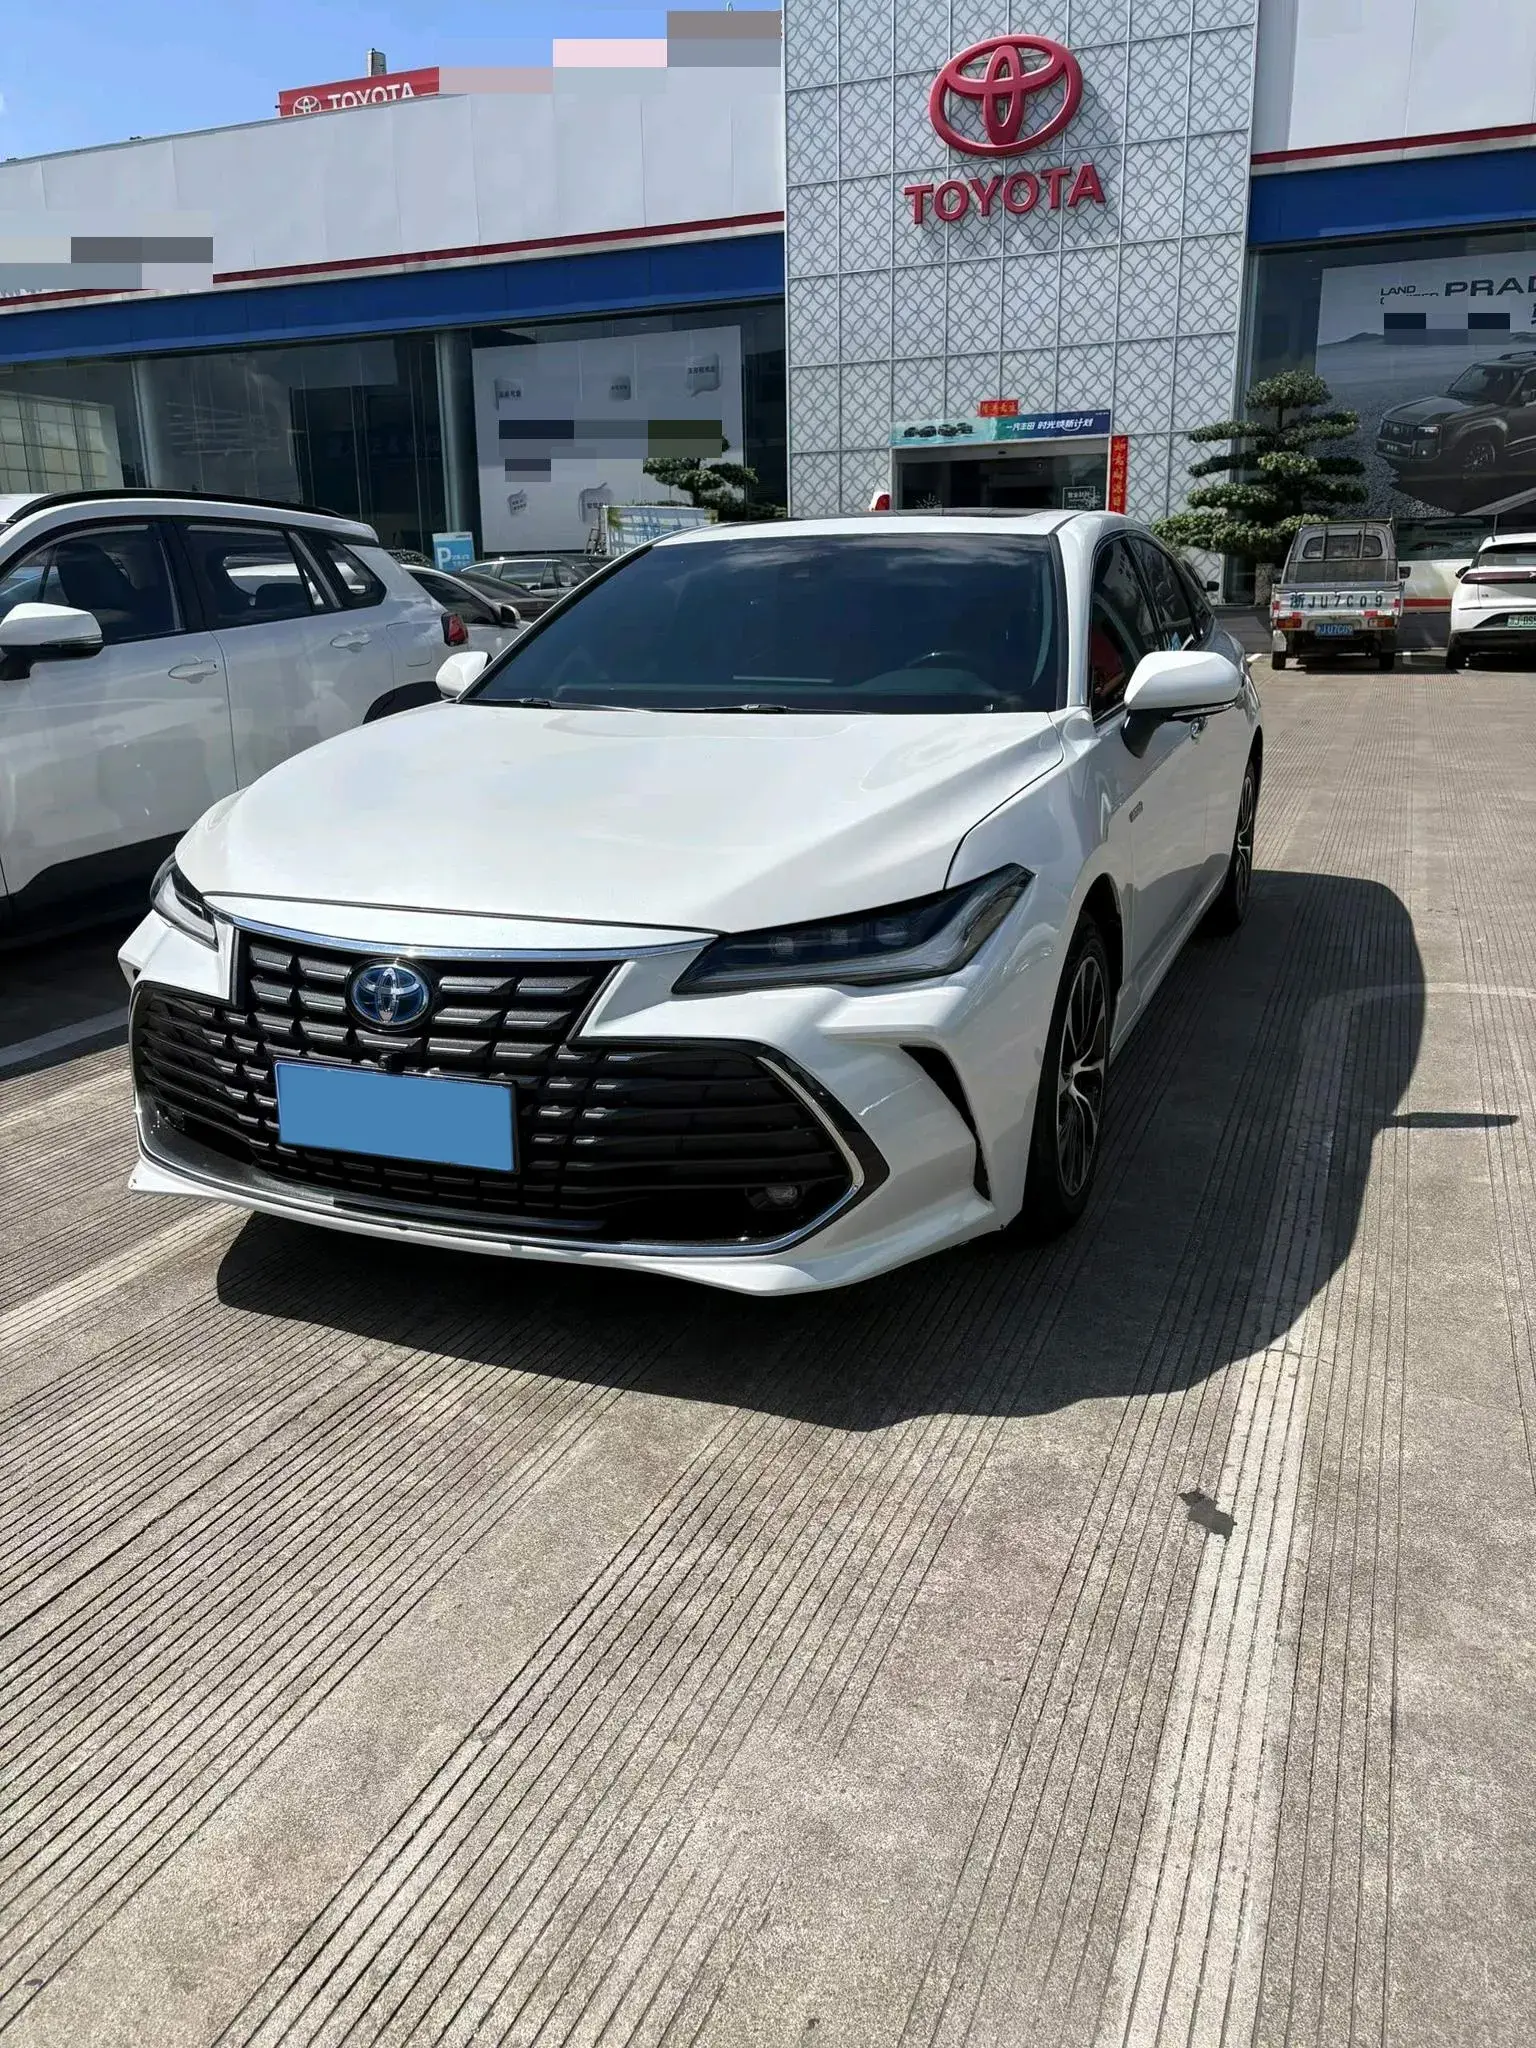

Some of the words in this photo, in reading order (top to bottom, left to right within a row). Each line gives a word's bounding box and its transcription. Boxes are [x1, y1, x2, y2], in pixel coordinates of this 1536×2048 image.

[327, 82, 415, 109] TOYOTA
[904, 162, 1107, 225] TOYOTA
[1380, 285, 1417, 296] LAND
[1005, 422, 1035, 431] 一汽丰田
